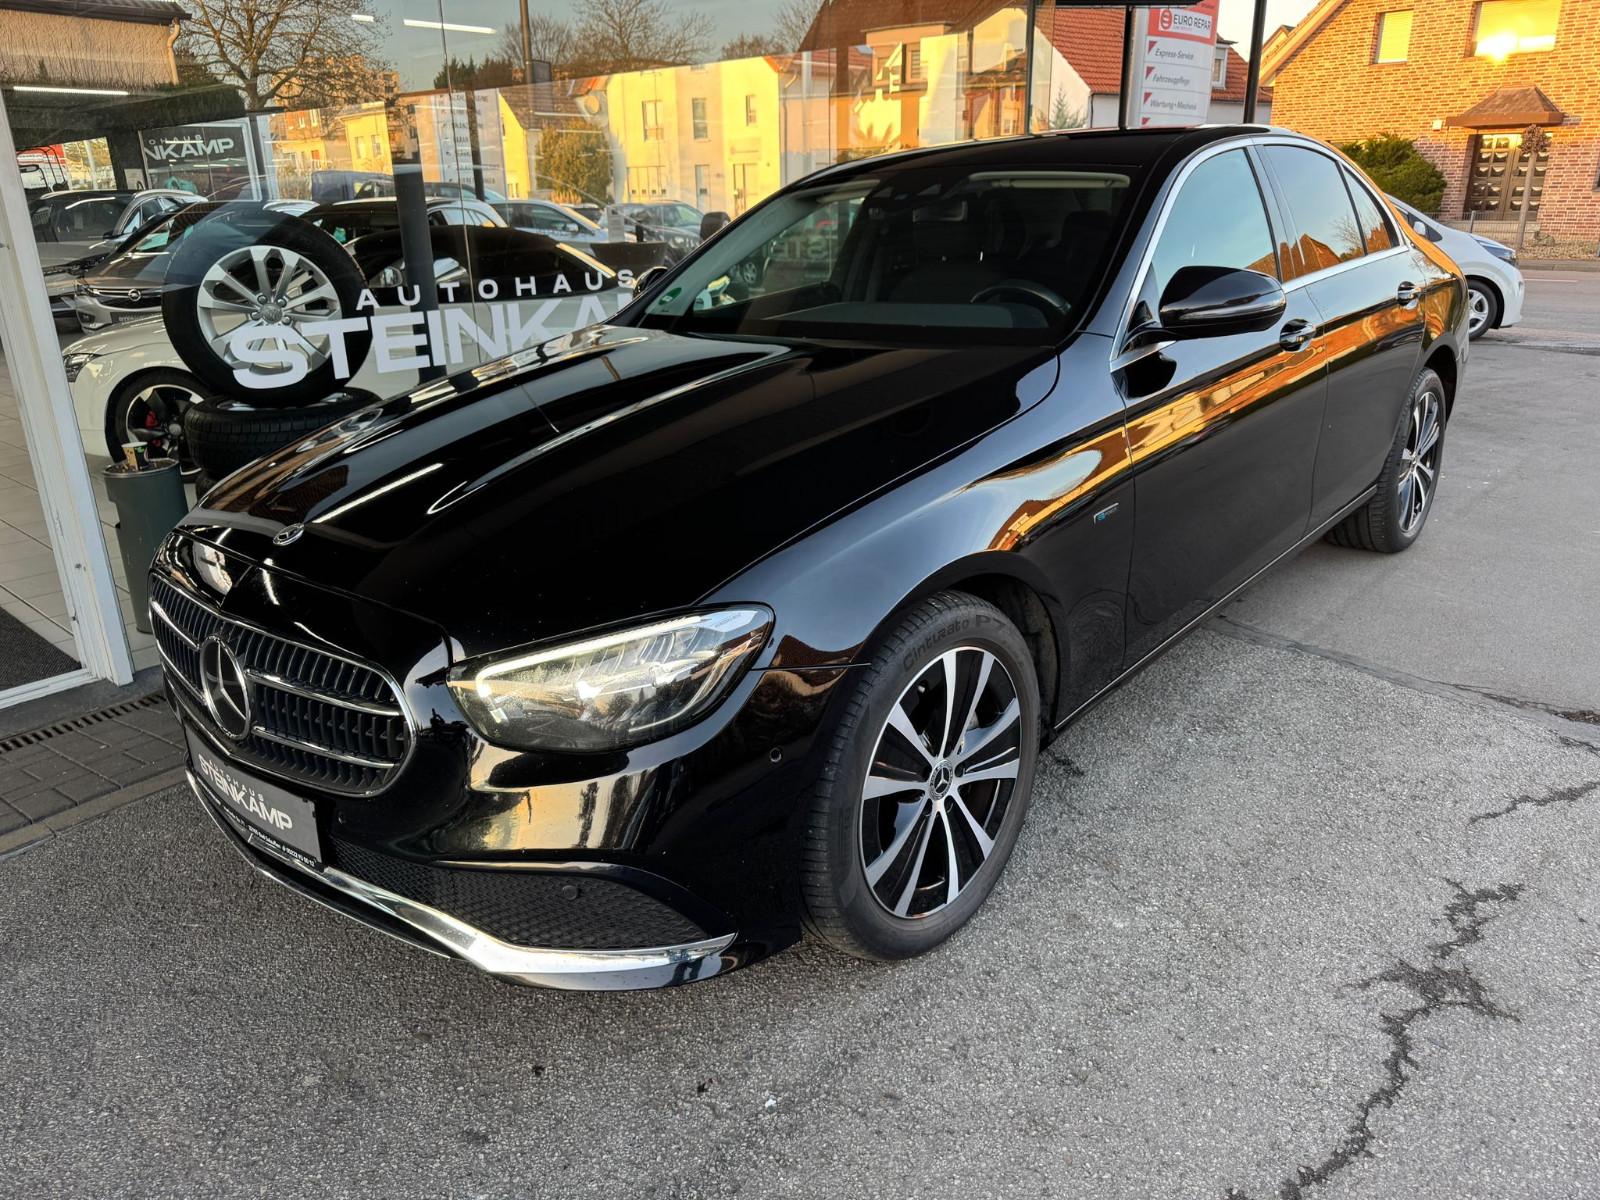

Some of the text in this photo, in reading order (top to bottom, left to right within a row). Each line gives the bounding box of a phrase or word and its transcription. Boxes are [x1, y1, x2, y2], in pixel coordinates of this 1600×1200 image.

[1173, 14, 1193, 27] EURO
[356, 269, 635, 311] AUTOHAUS
[231, 293, 634, 389] STEINKA
[198, 753, 294, 831] STEINKAMP
